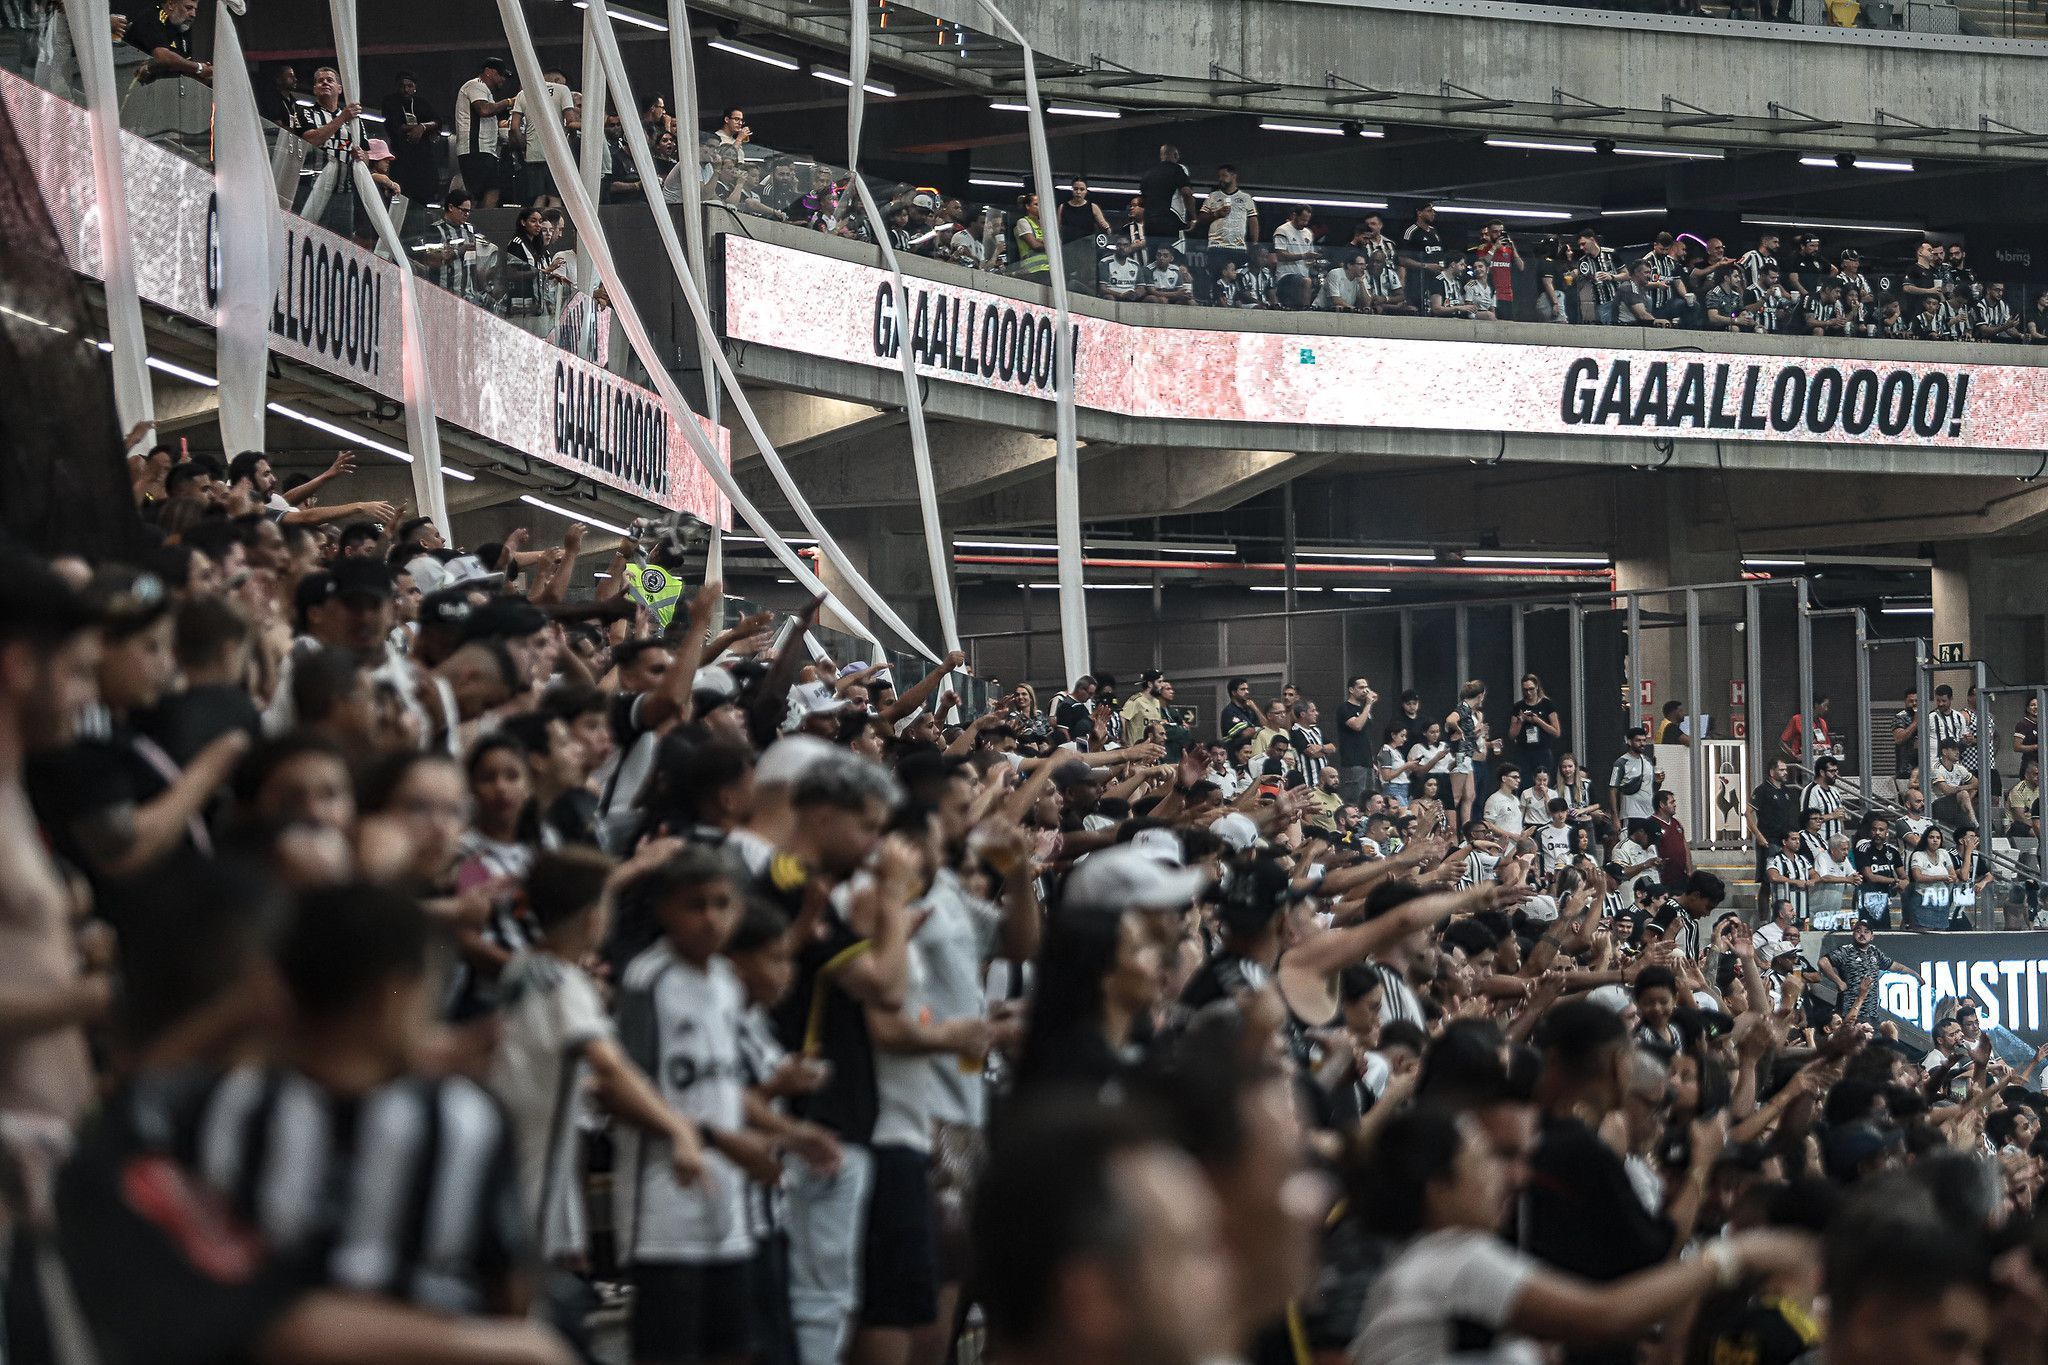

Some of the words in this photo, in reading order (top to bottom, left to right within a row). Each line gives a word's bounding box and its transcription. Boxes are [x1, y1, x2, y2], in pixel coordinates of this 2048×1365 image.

[874, 281, 1079, 392] GAALLOOOO!
[554, 360, 668, 495] GAAALLOOOOO!
[1561, 357, 1969, 437] GAAALLOOOOO!
